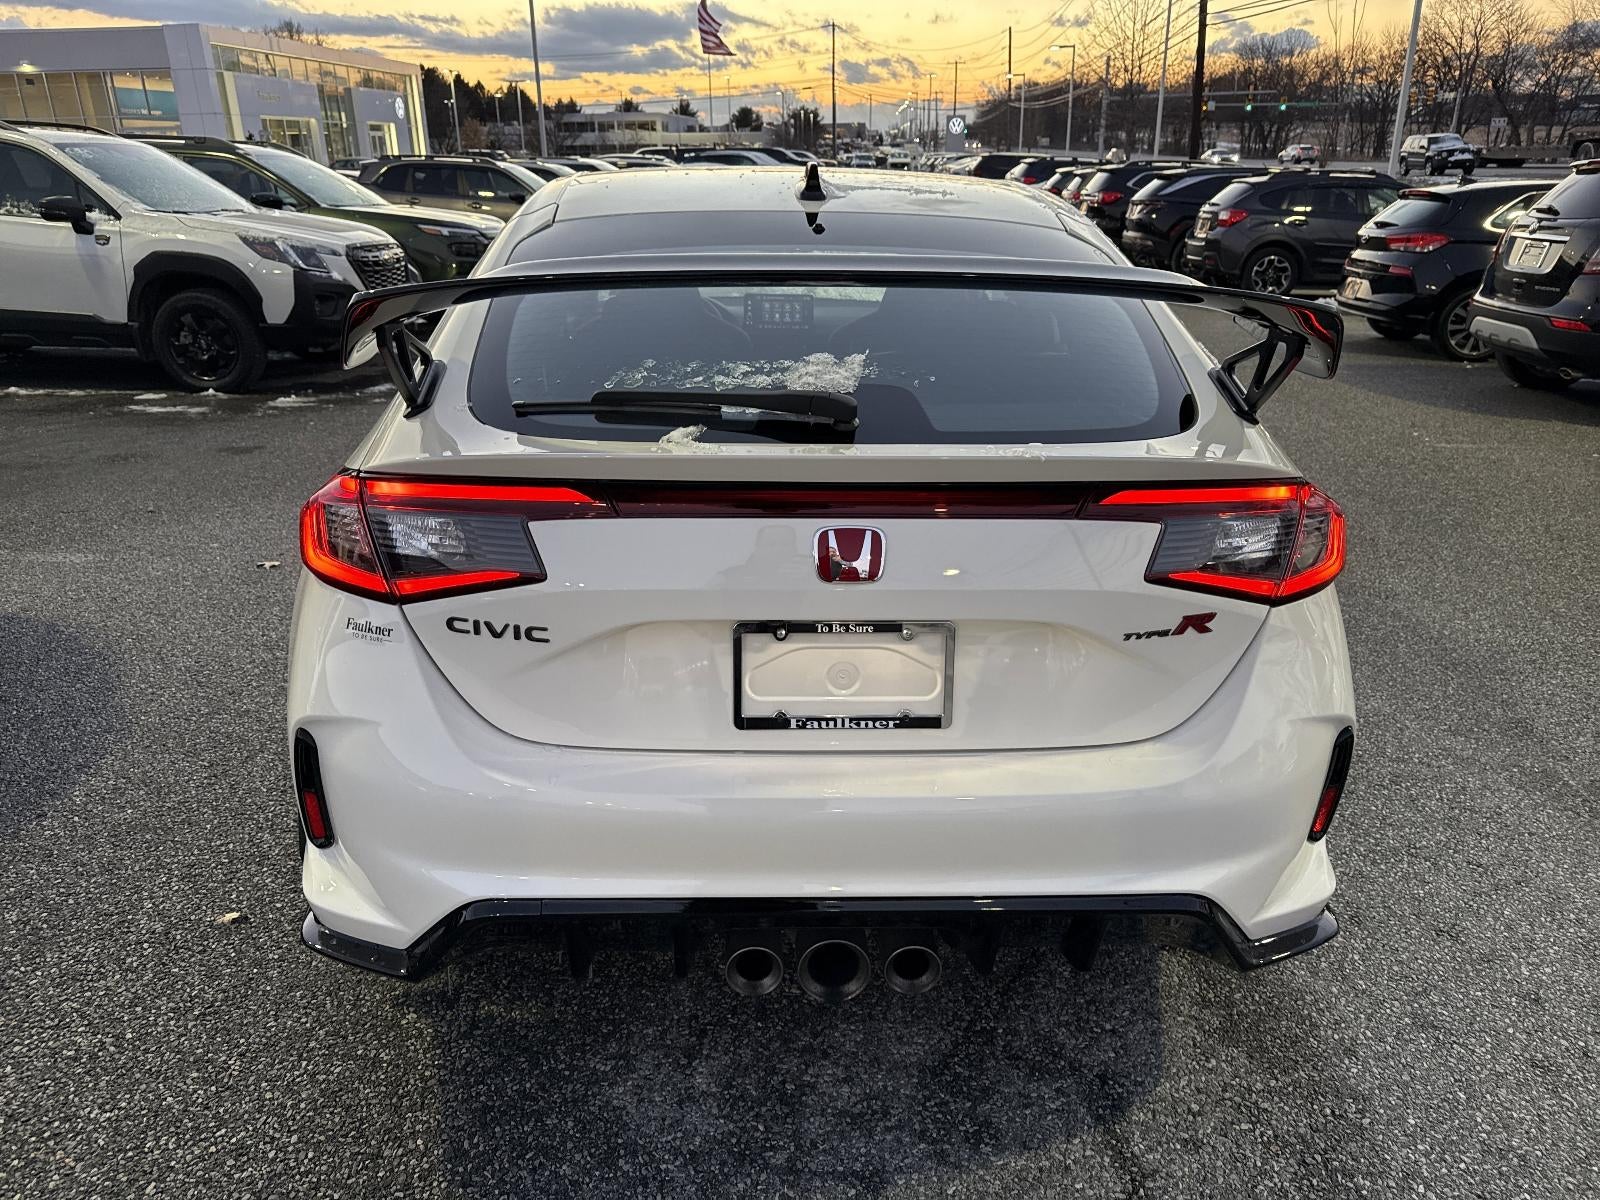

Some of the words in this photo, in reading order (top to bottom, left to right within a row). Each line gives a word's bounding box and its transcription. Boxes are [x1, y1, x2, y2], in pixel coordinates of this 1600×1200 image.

[345, 617, 394, 638] Faulkner
[445, 616, 551, 643] CIVIC
[815, 623, 829, 633] To
[832, 623, 846, 633] Be
[848, 623, 874, 633] Sure
[1123, 628, 1172, 642] TYPE
[1170, 611, 1218, 636] R
[789, 718, 900, 729] Faulkner
